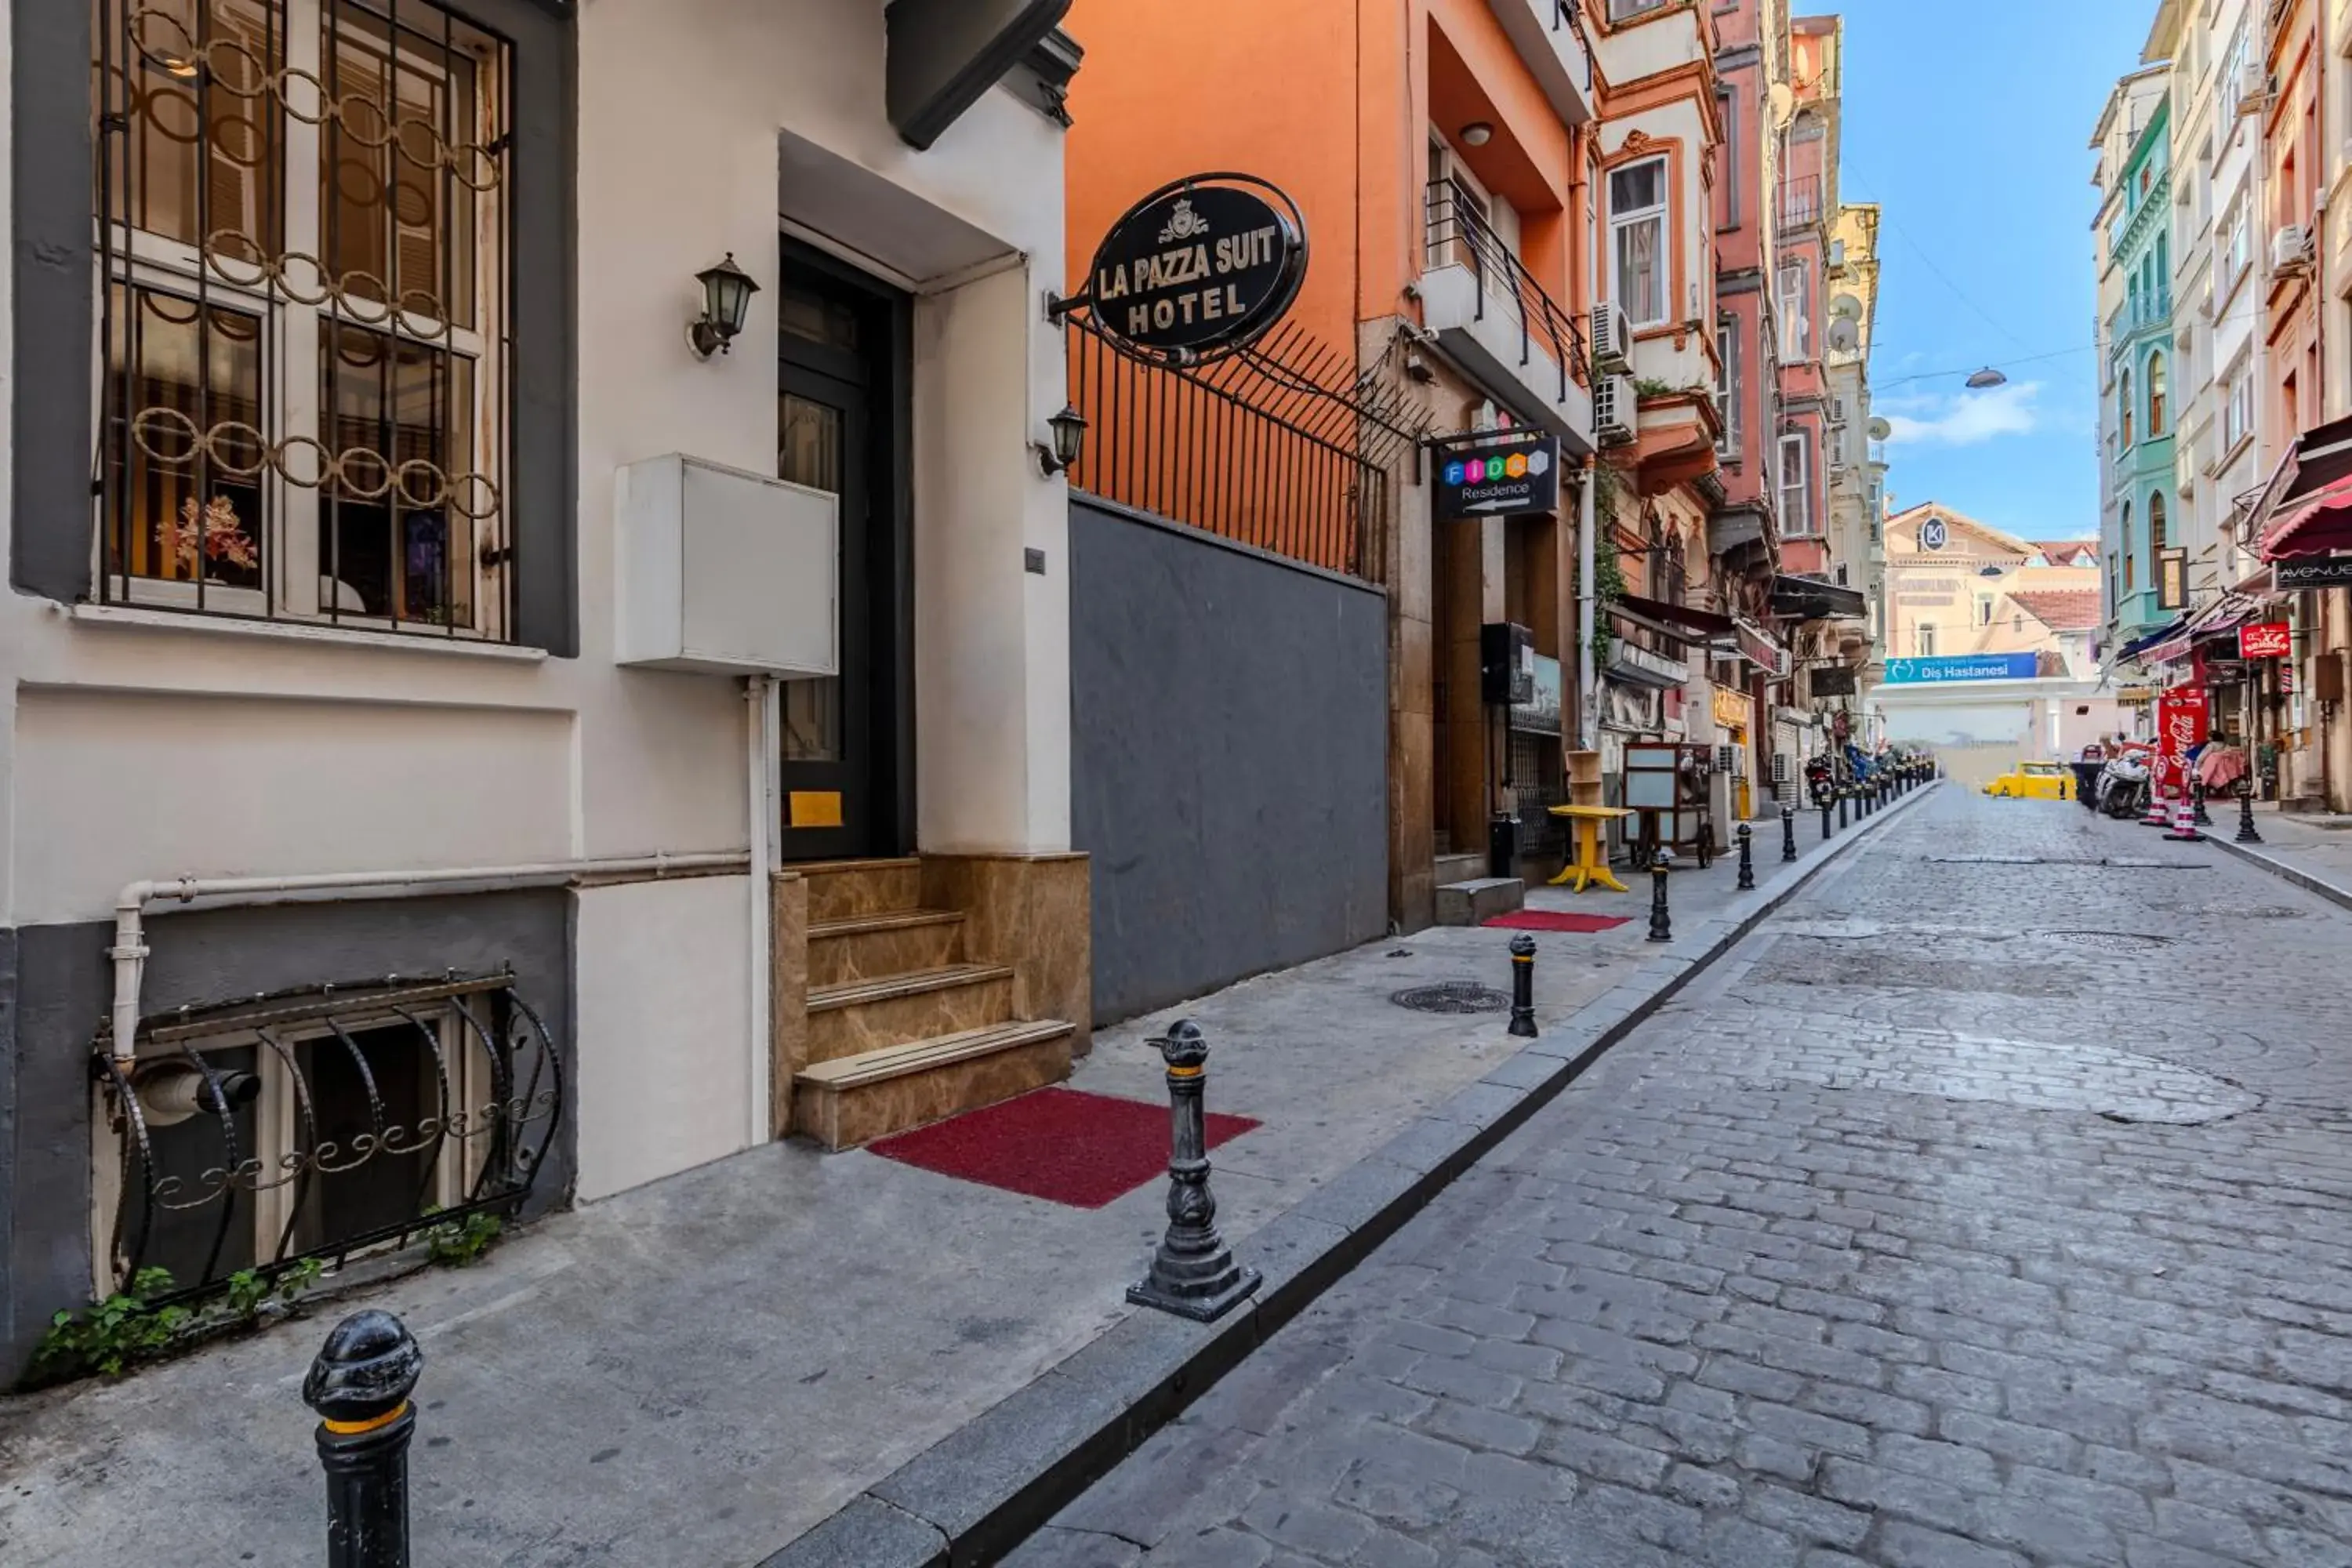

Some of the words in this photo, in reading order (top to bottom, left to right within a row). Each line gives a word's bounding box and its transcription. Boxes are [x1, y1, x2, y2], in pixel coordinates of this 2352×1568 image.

[1100, 264, 1128, 300] LA
[1134, 244, 1210, 292] PAZZA
[1217, 225, 1276, 274] SUIT
[1129, 283, 1246, 335] HOTEL
[1462, 483, 1529, 499] Residence
[1922, 666, 1942, 681] Diş
[1944, 663, 2008, 678] Hastanesi
